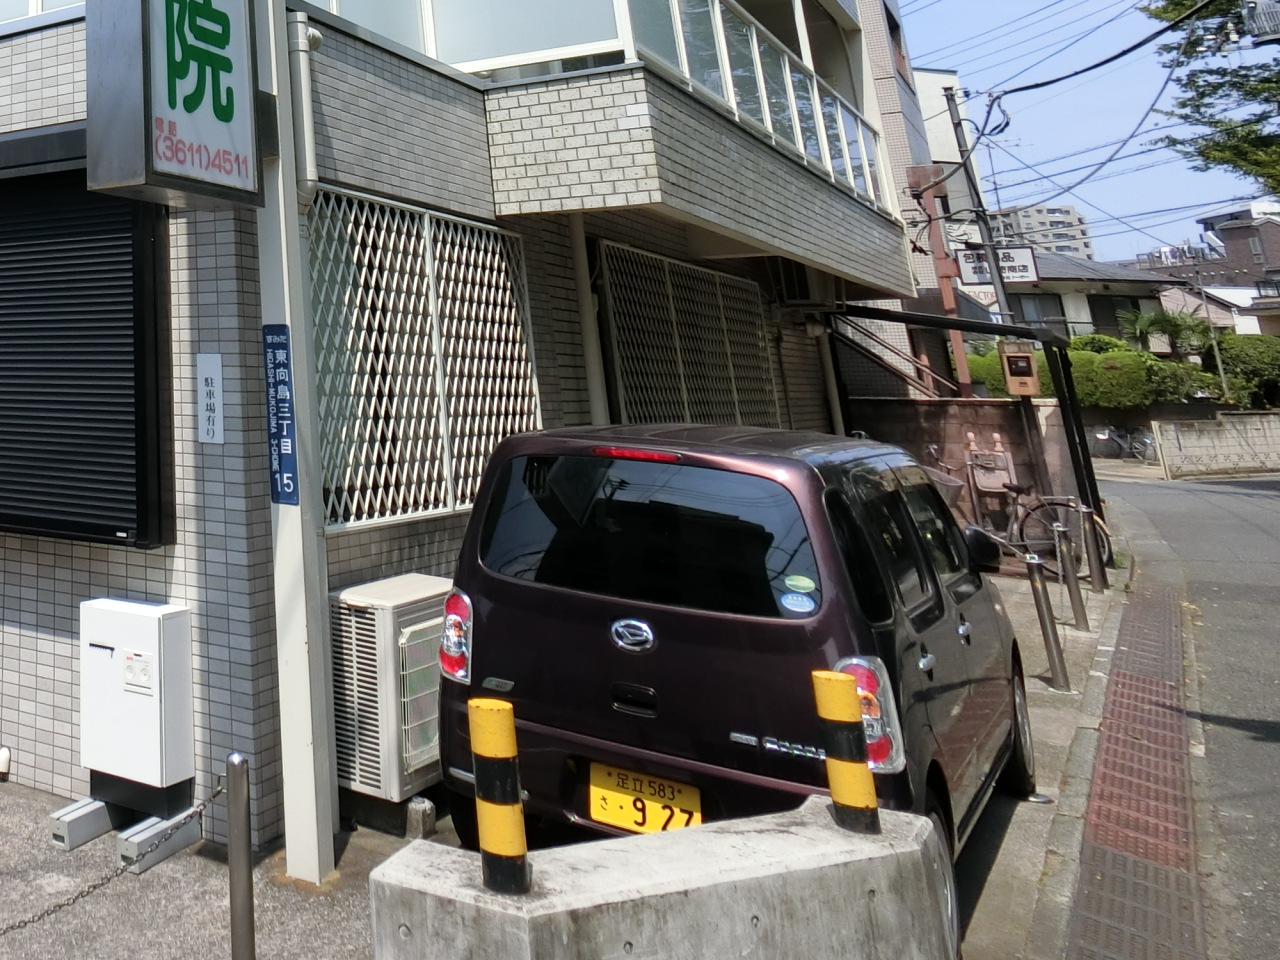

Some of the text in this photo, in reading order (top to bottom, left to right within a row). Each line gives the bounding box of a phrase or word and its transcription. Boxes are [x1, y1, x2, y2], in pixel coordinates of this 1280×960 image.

[155, 134, 249, 179] (3611)4511
[265, 335, 288, 344] すみだ
[204, 376, 217, 440] 駐車場有り
[266, 349, 279, 434] HIGASHI-MUKOJIMA
[274, 349, 293, 455] 東向島三丁目
[274, 473, 295, 493] 15
[600, 795, 609, 811] さ
[616, 772, 676, 801] 足立 583
